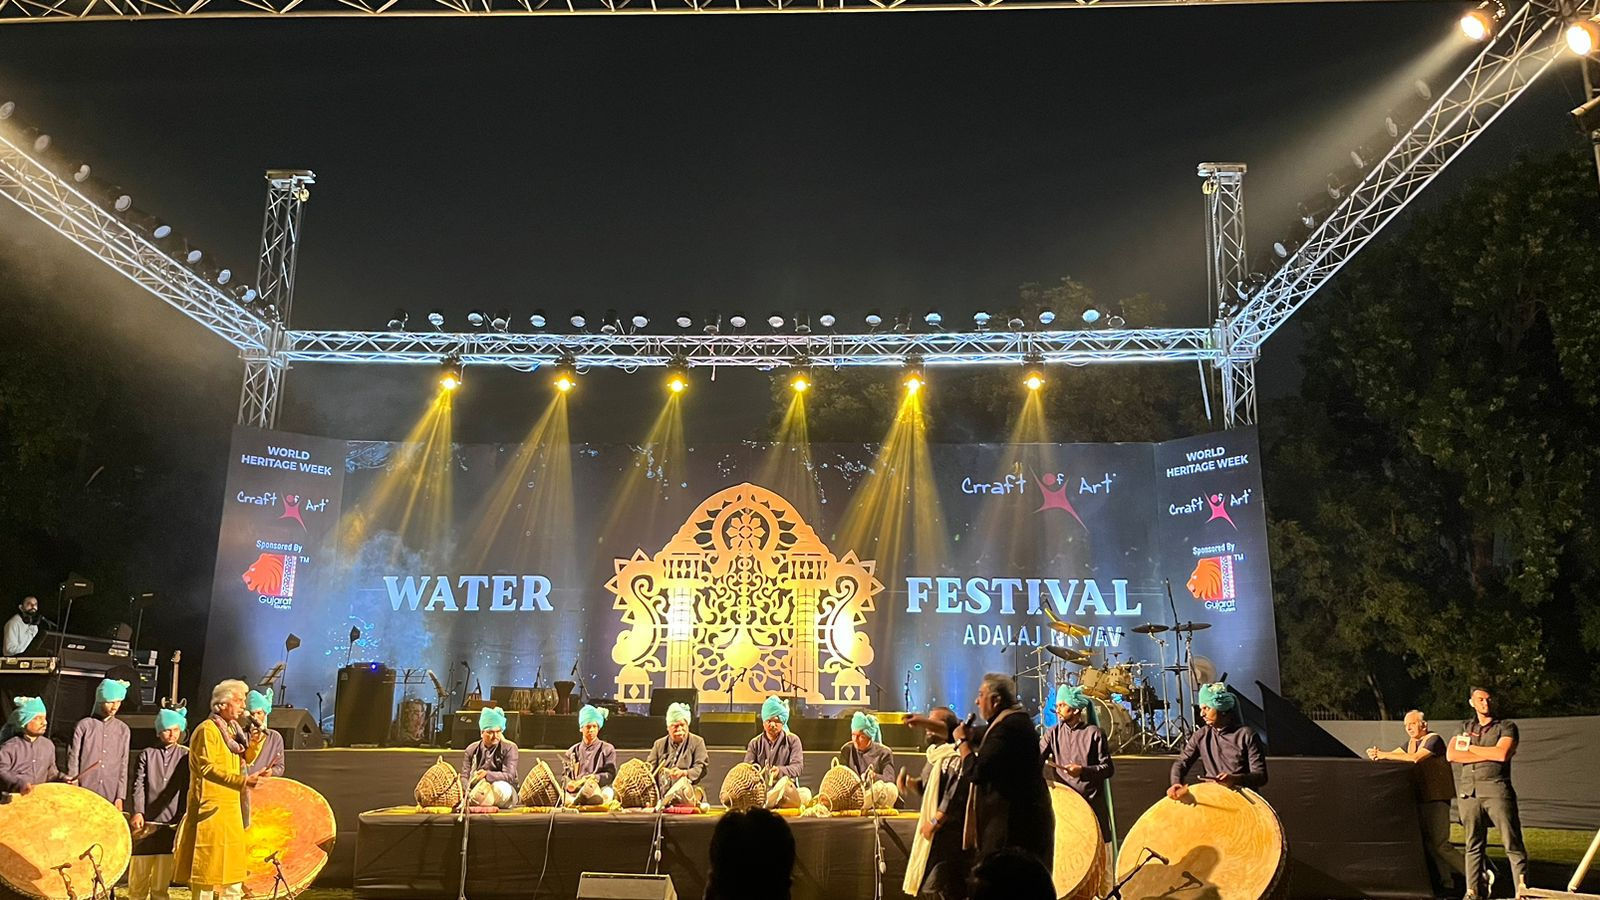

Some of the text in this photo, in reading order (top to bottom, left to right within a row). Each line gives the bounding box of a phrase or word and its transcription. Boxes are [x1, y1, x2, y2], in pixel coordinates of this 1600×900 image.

[267, 445, 310, 460] WORLD
[1186, 446, 1226, 462] WORLD
[241, 454, 333, 476] HERITAGE WEEK
[1166, 454, 1249, 478] HERITAGE WEEK
[961, 472, 1027, 495] Crraft
[1079, 472, 1113, 495] Art
[236, 490, 278, 507] Crraft
[305, 498, 327, 512] Art
[1168, 496, 1204, 515] Crraft
[1230, 489, 1249, 507] Art
[255, 540, 303, 553] Sponsored By
[1192, 542, 1236, 556] Sponsored By
[299, 555, 310, 563] TM
[258, 595, 293, 606] Gujarat
[382, 575, 1142, 616] WATER FESTIVAL
[1204, 599, 1236, 610] Gujarat
[962, 623, 1041, 647] ADALAJ
[1083, 625, 1122, 647] VAV
